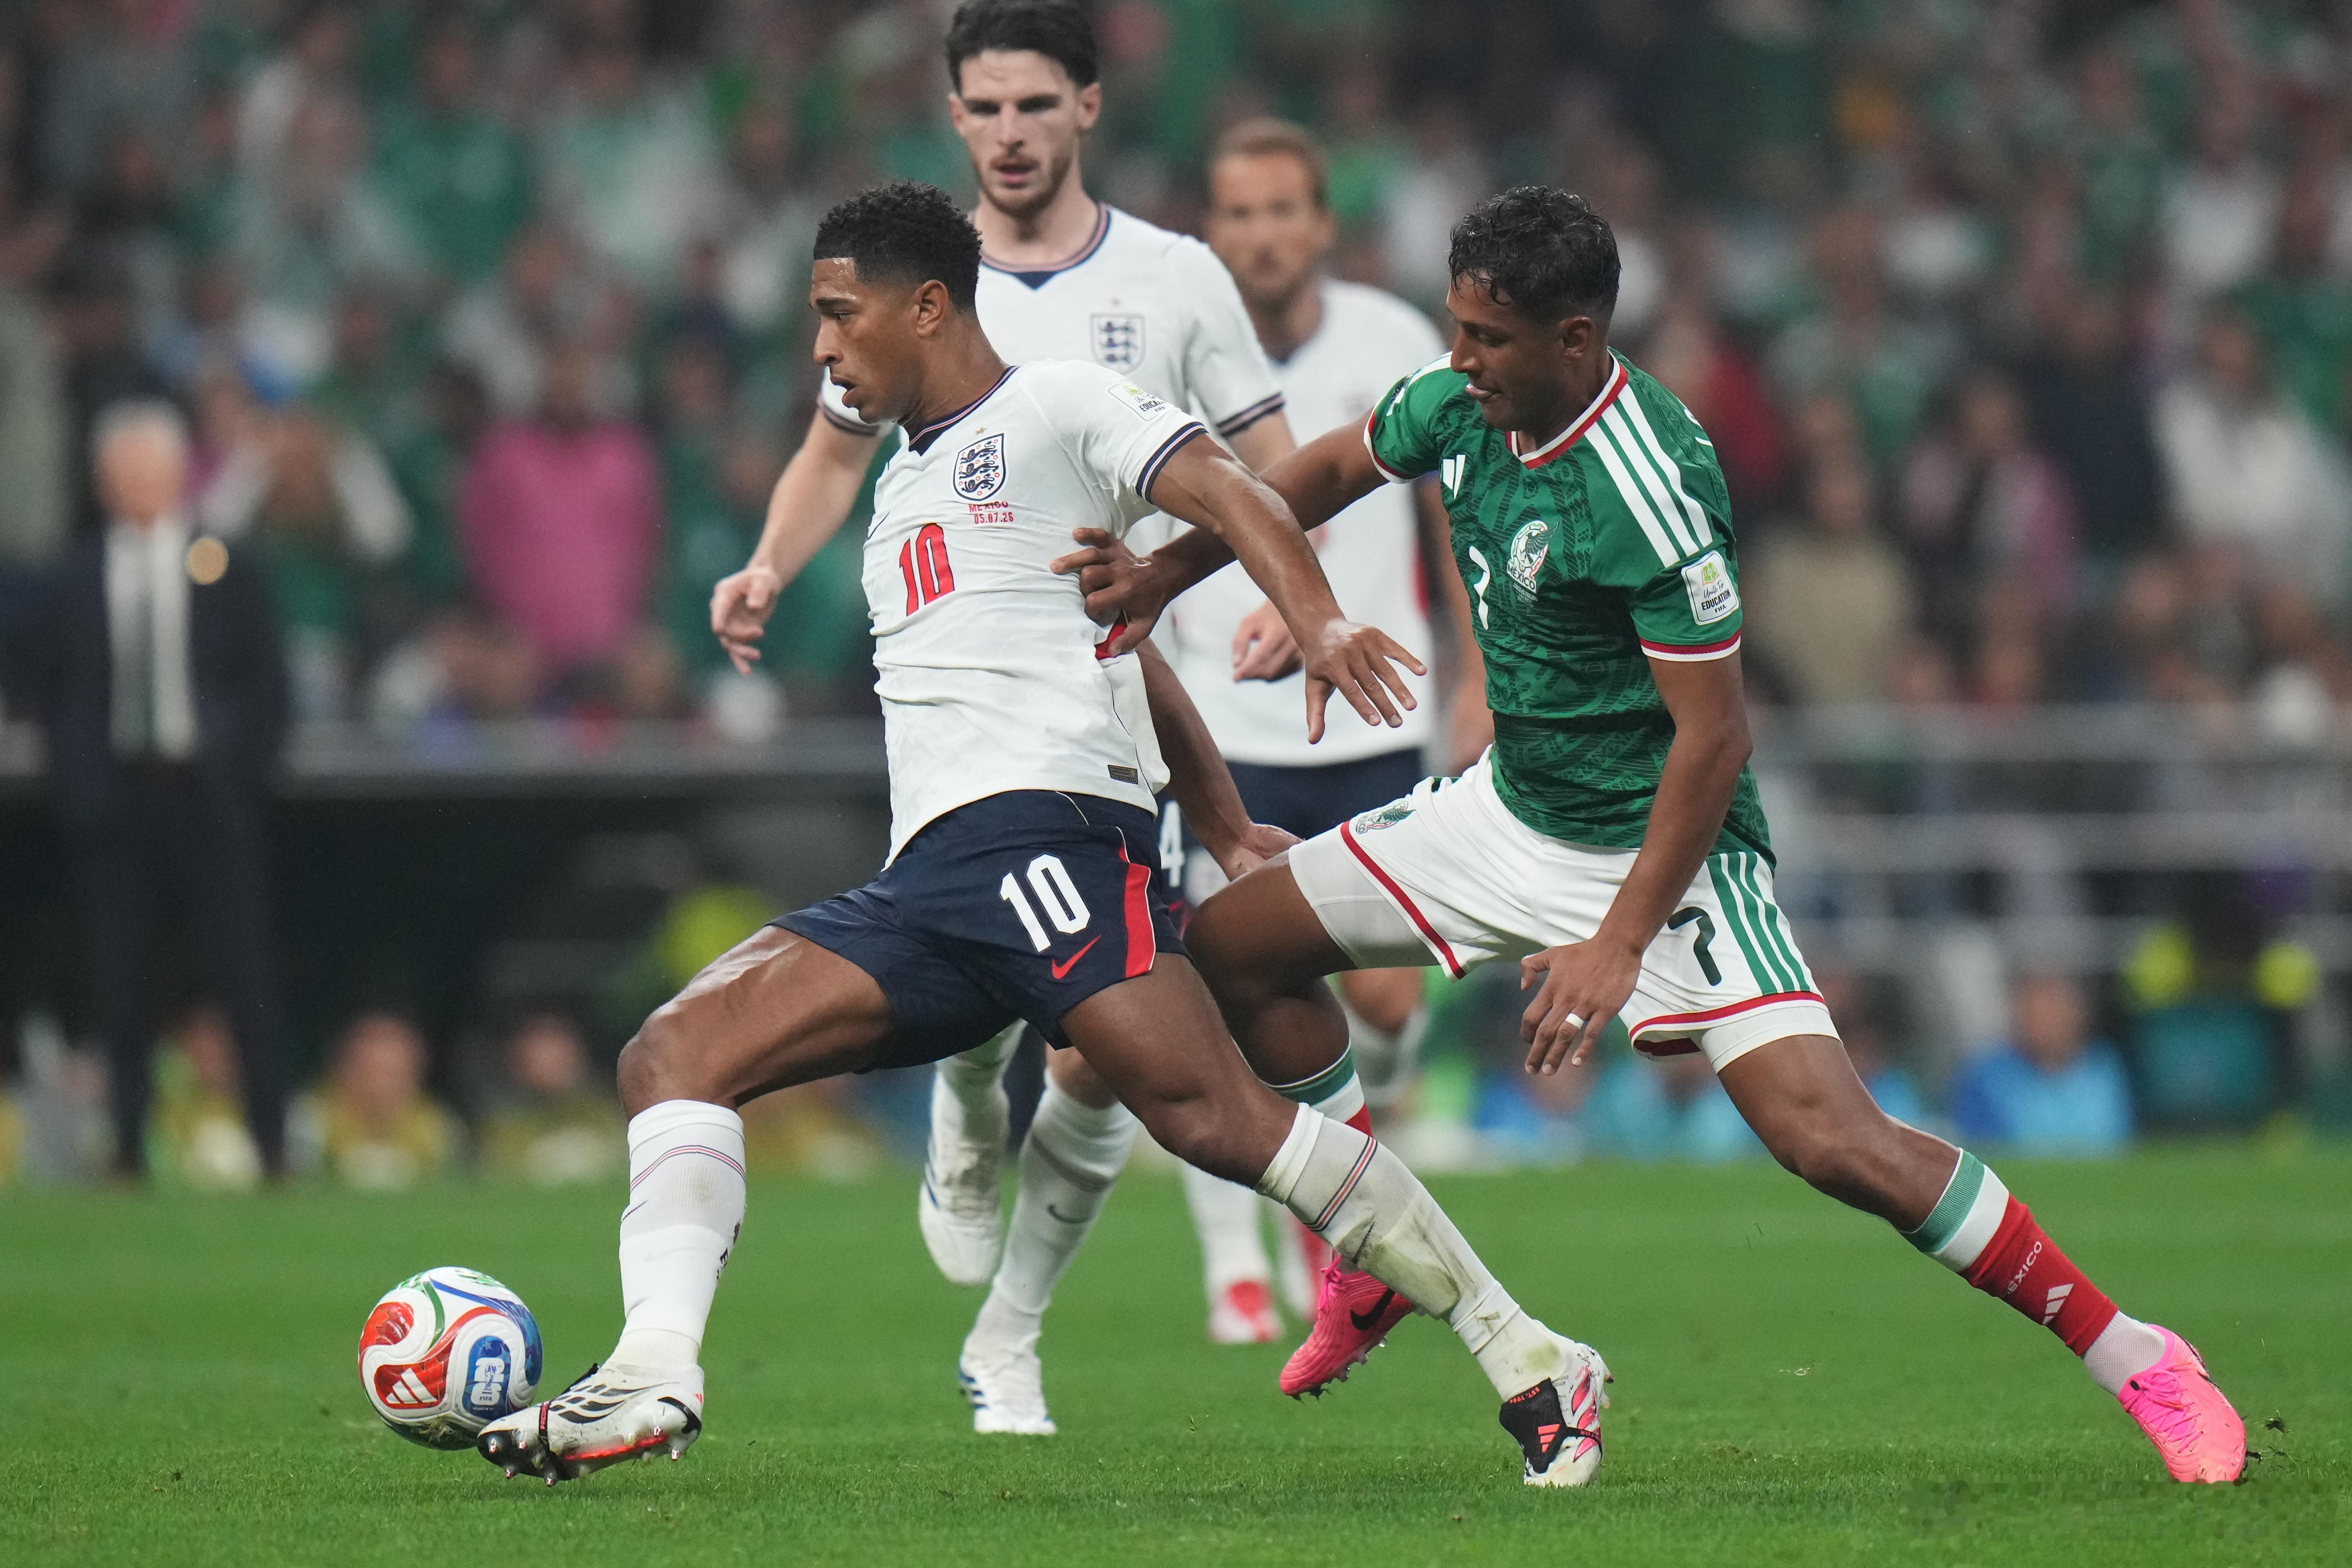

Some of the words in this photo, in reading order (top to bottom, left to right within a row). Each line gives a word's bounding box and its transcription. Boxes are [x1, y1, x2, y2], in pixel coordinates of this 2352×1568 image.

[974, 512, 1013, 524] 05.07.26
[899, 523, 955, 616] 10
[1508, 563, 1535, 590] MÉXICO
[1701, 588, 1731, 610] EDUCATION
[1703, 585, 1717, 599] Unite
[1715, 605, 1726, 613] FIFA
[1159, 800, 1186, 887] 4
[1000, 854, 1091, 952] 10
[1668, 906, 1722, 986] 7
[2007, 1241, 2042, 1294] EXICO
